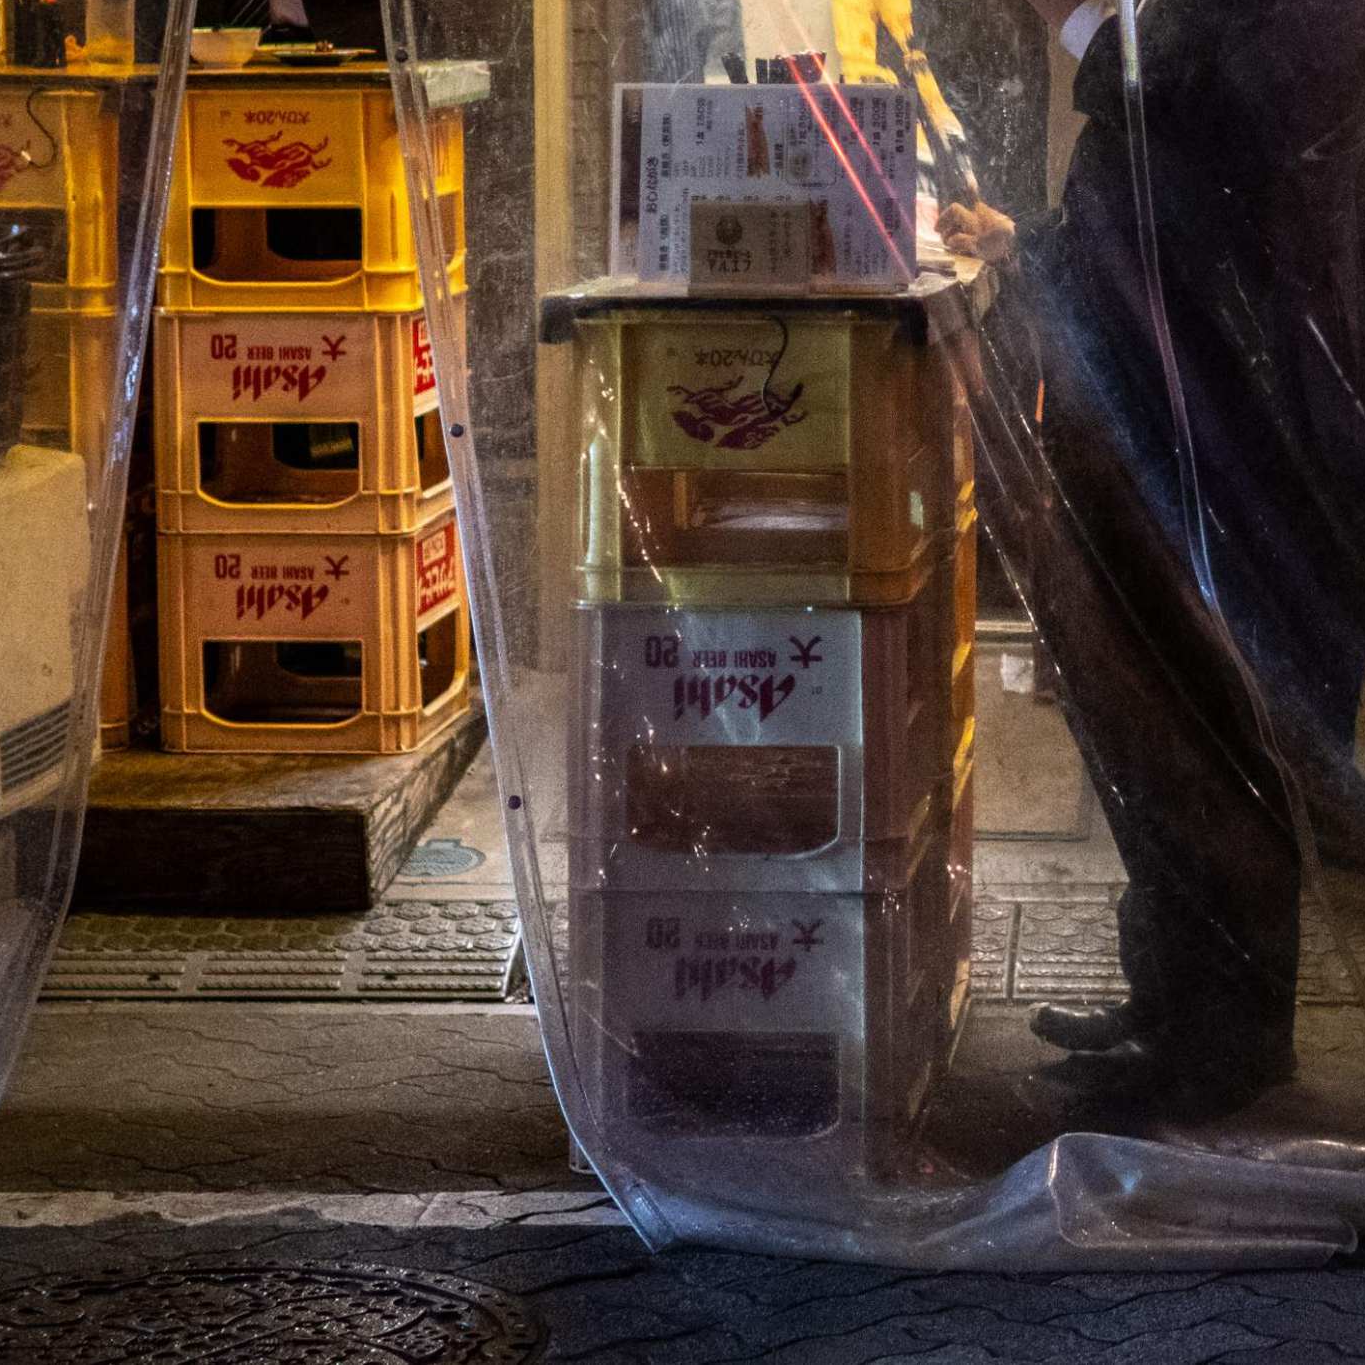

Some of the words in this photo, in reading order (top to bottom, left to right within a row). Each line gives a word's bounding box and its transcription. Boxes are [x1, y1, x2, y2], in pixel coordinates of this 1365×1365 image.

[211, 334, 237, 360] 20
[247, 346, 274, 360] BEER
[279, 346, 312, 360] ASAHI
[322, 335, 347, 361] 大
[232, 365, 327, 402] Asahi
[215, 554, 241, 579] 20
[251, 565, 277, 579] BEER
[282, 565, 315, 580] ASAHI
[325, 555, 350, 580] 大
[236, 584, 330, 620] Asahi
[645, 636, 678, 668] 20
[693, 650, 726, 668] BEER
[734, 650, 777, 668] ASAHI
[789, 636, 823, 668] 大
[674, 674, 795, 722] Asahi
[673, 957, 796, 1001] Asahi
